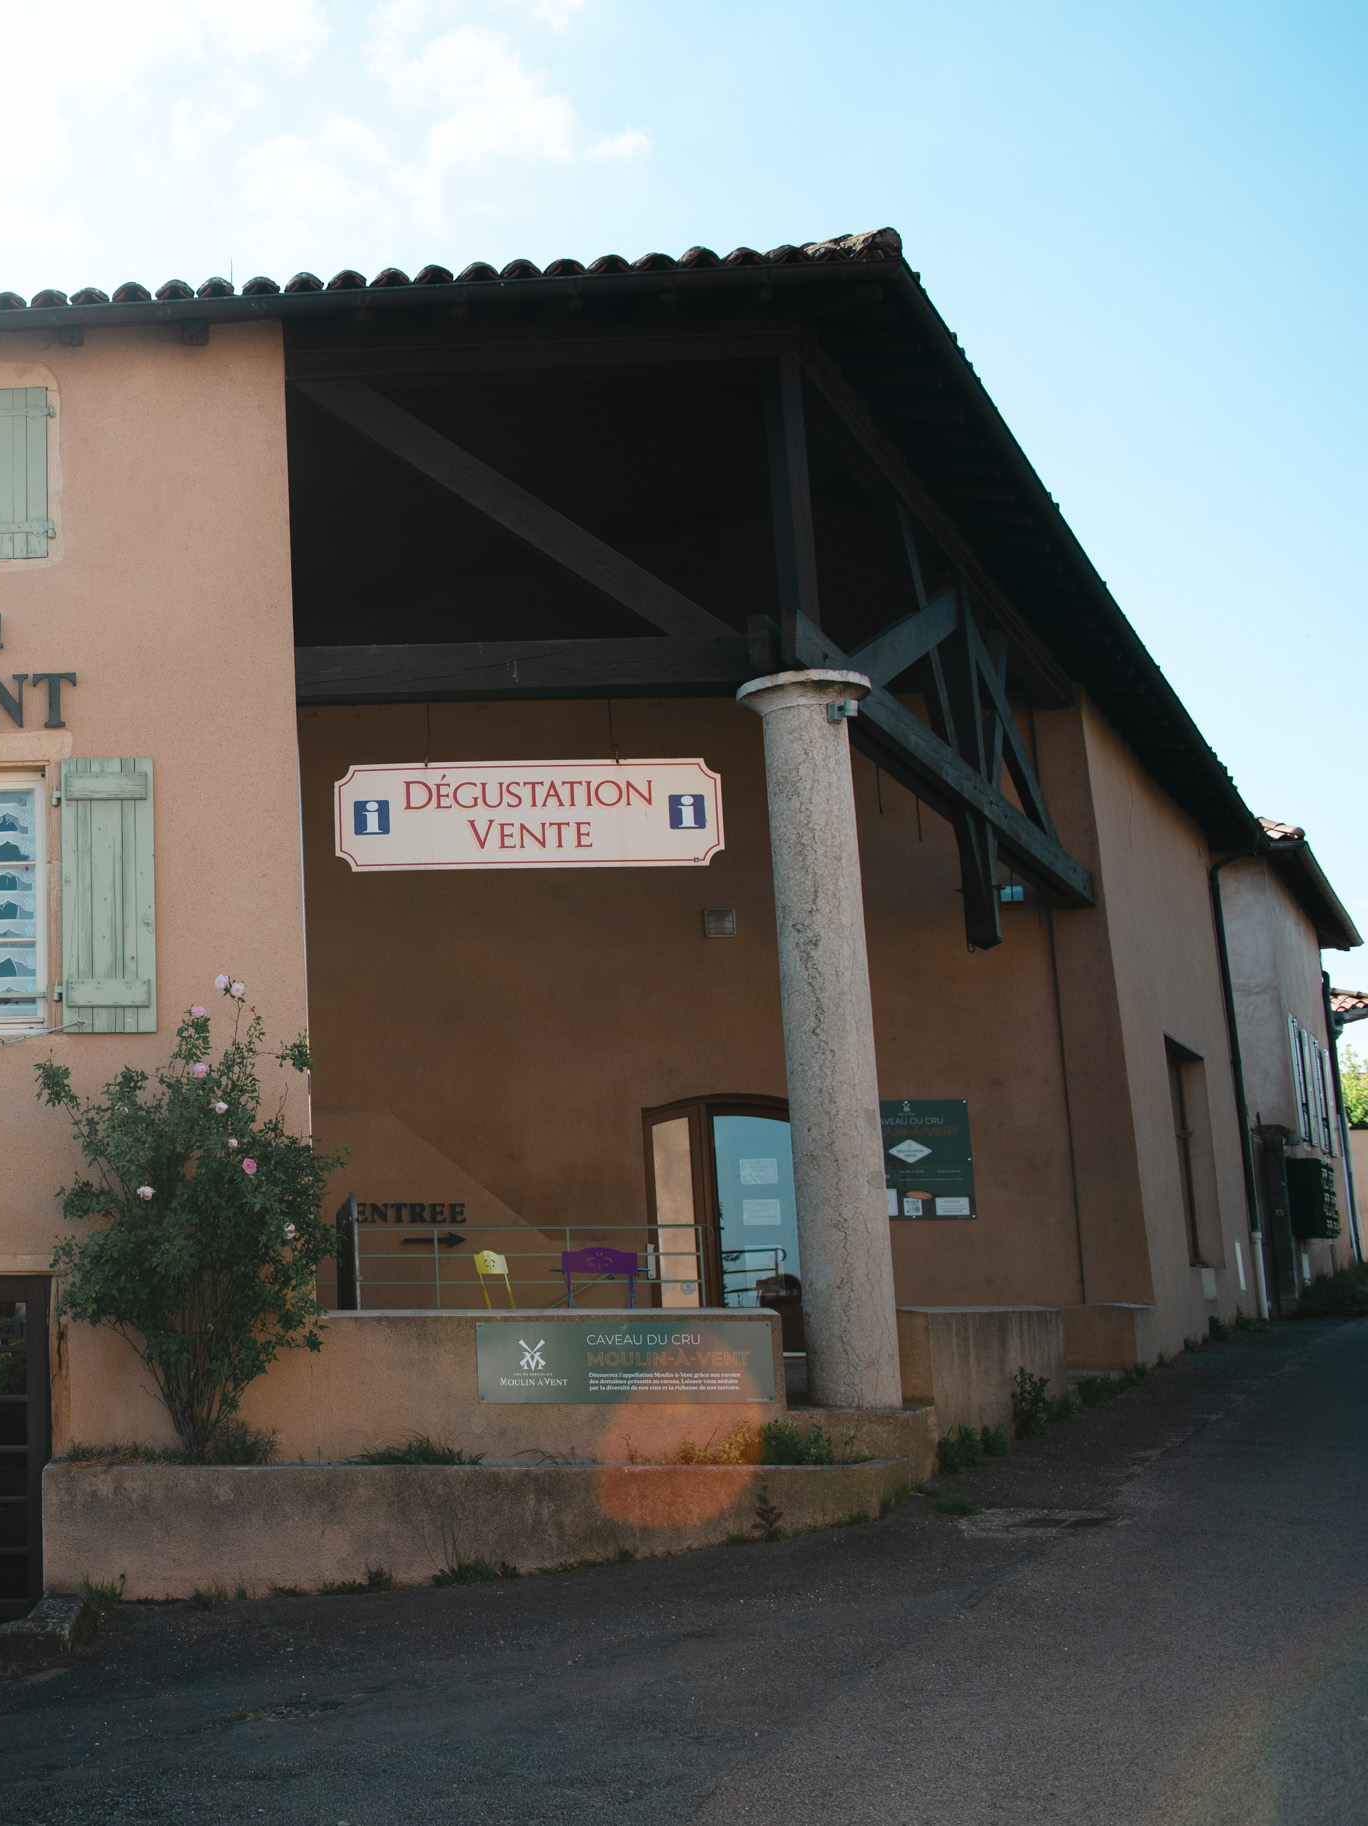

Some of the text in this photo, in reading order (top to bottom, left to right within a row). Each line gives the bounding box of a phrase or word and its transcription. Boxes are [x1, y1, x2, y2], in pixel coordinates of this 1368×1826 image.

[402, 774, 654, 811] DÉGUSTATION
[466, 819, 594, 850] VENTE
[909, 1117, 923, 1126] DU
[924, 1117, 944, 1126] CRU
[357, 1203, 466, 1223] ENTREE
[587, 1334, 701, 1346] CAVEAU DU CRU
[587, 1347, 751, 1367] MOULIN-À-VENT
